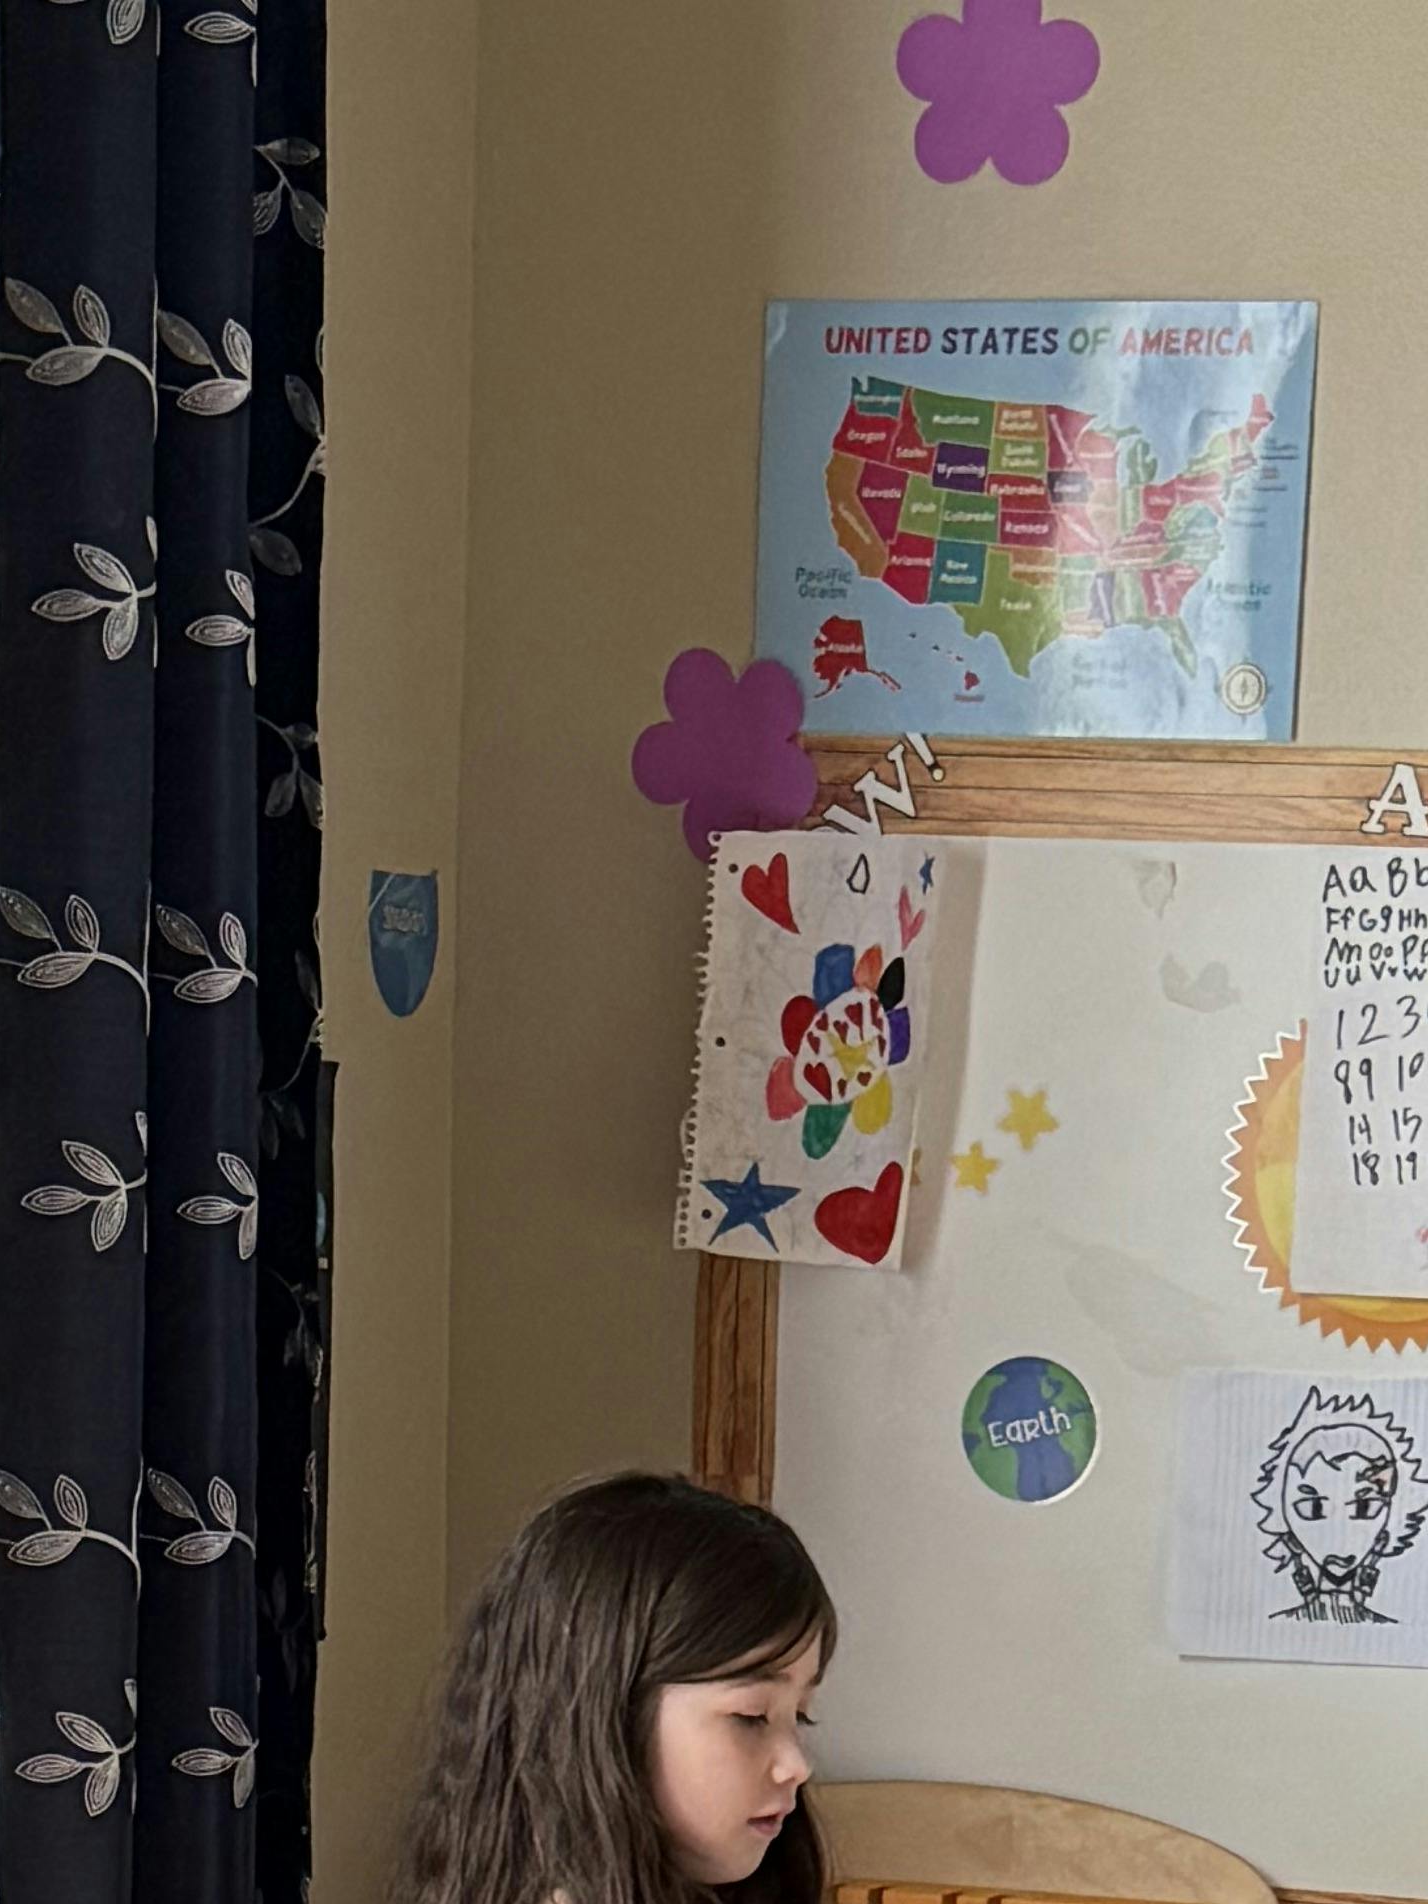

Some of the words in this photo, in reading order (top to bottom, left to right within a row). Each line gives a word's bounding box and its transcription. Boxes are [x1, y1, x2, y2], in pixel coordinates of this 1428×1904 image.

[824, 326, 932, 355] UNITED
[940, 326, 1060, 356] STATES
[1068, 327, 1112, 357] OF
[1118, 326, 1254, 357] AMERICA
[1336, 1009, 1345, 1050] 1
[1357, 1003, 1390, 1046] 2
[1396, 995, 1421, 1039] 3
[1334, 1059, 1353, 1105] 8
[1358, 1057, 1375, 1102] 9
[1398, 1052, 1425, 1092] 10
[1349, 1113, 1373, 1146] 14
[1392, 1106, 1423, 1144] 15
[1353, 1152, 1380, 1186] 18
[1395, 1151, 1418, 1186] 19
